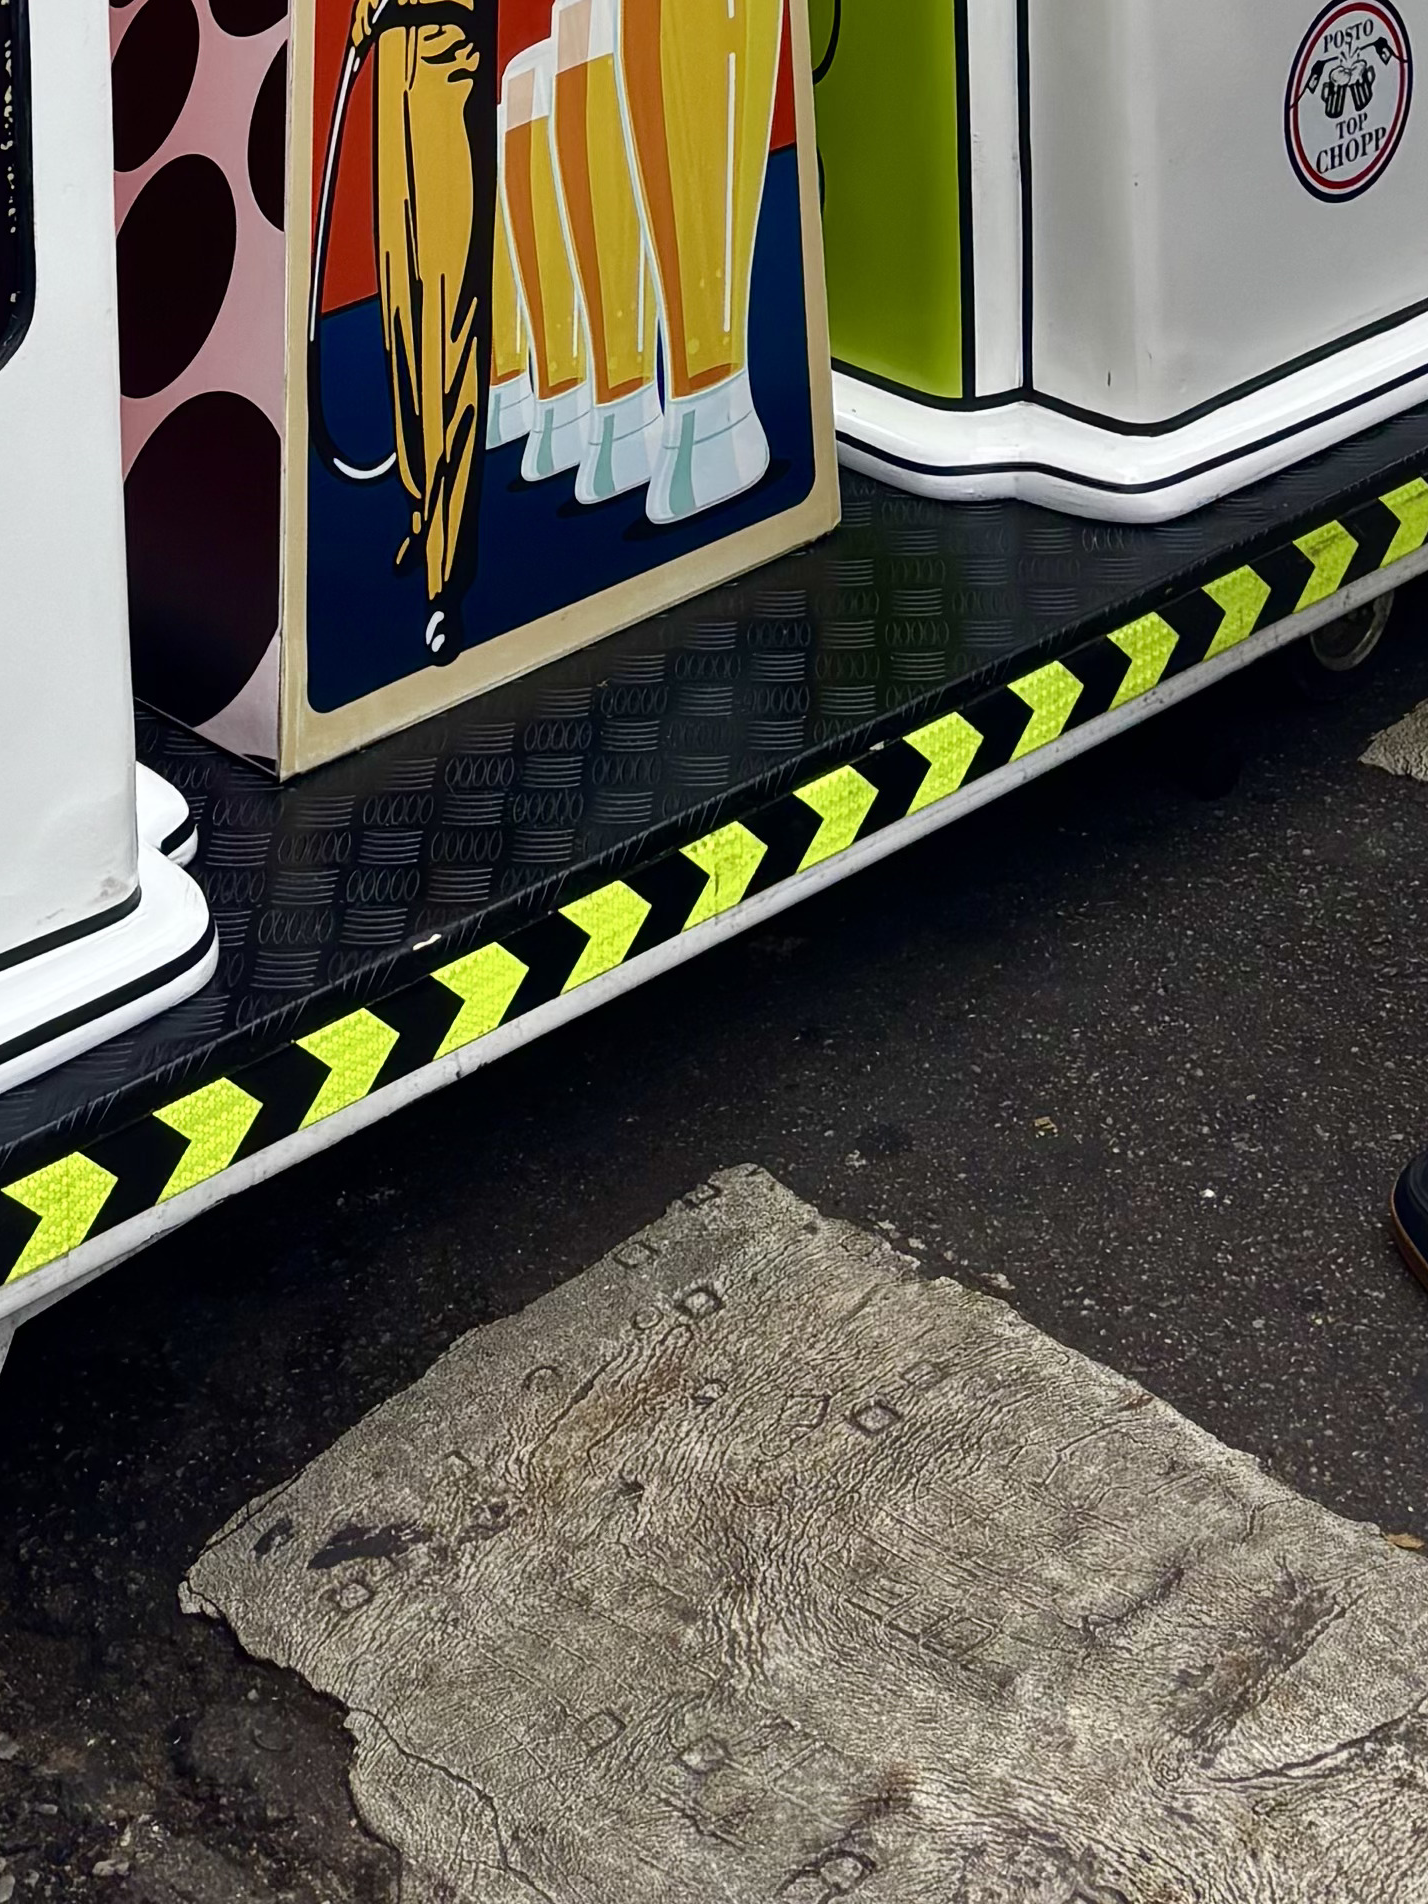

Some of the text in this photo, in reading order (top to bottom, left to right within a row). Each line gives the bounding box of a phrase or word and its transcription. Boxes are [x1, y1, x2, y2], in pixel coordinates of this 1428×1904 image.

[1324, 19, 1373, 53] POSTO
[1336, 113, 1368, 140] TOP
[1316, 126, 1387, 174] CHOPP
